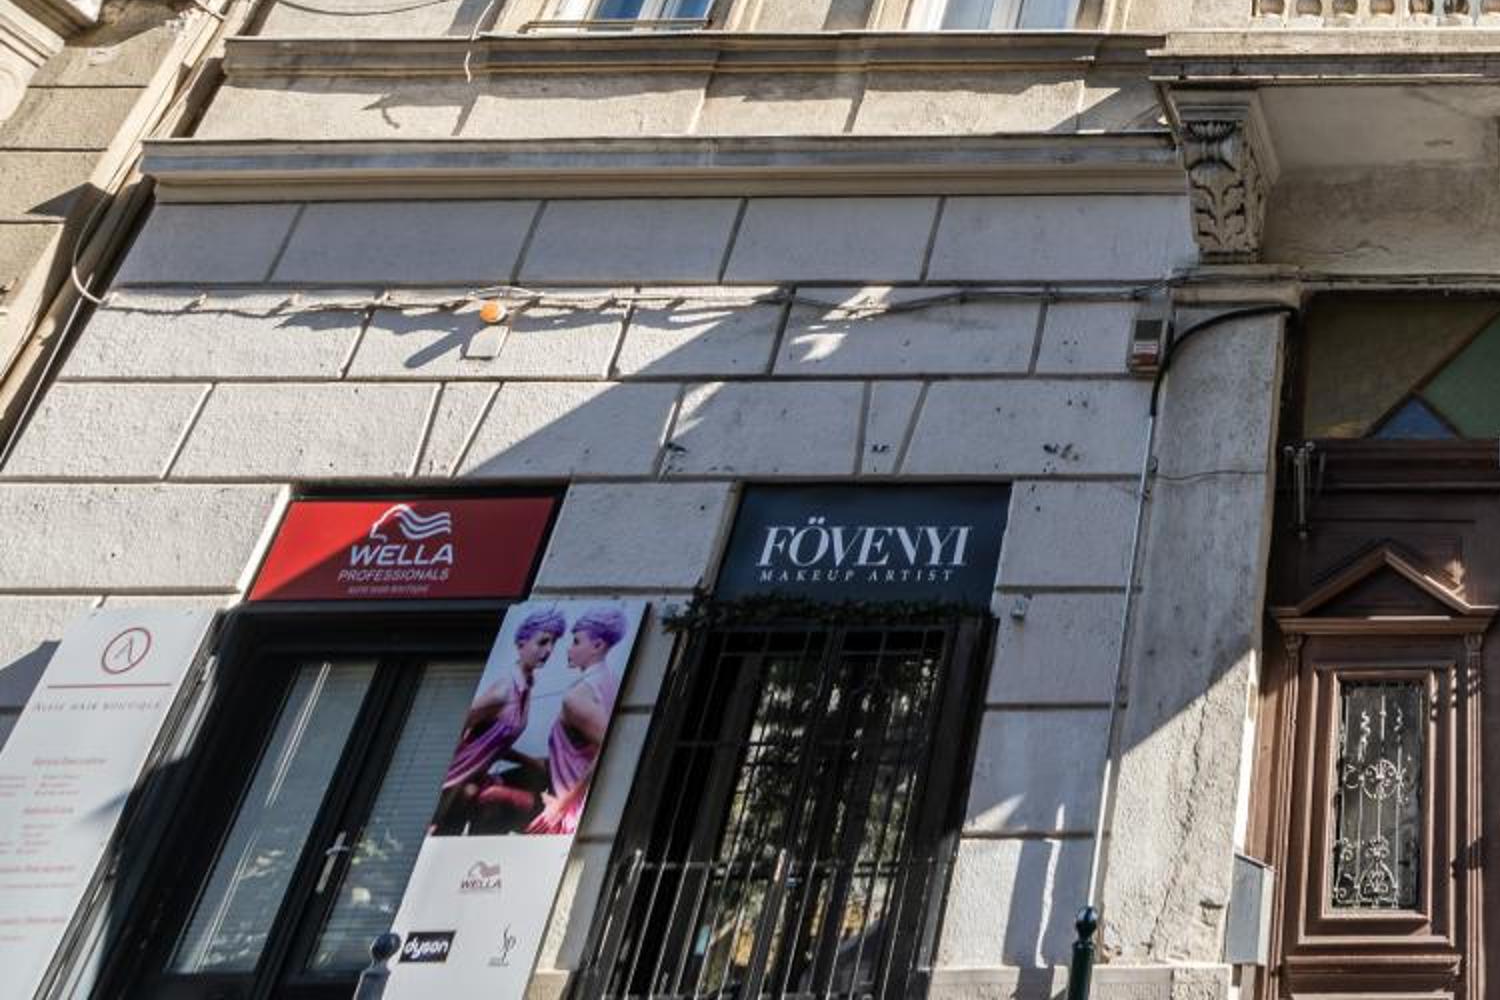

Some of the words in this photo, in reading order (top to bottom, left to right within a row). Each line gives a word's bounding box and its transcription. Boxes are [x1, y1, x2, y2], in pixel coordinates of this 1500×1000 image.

[756, 516, 974, 567] FÖVENYI
[350, 543, 454, 566] WELLA
[338, 567, 450, 581] PROFESSIONALS
[760, 569, 855, 583] MAKEUP
[868, 569, 954, 582] ARTIST
[405, 936, 449, 959] dyson
